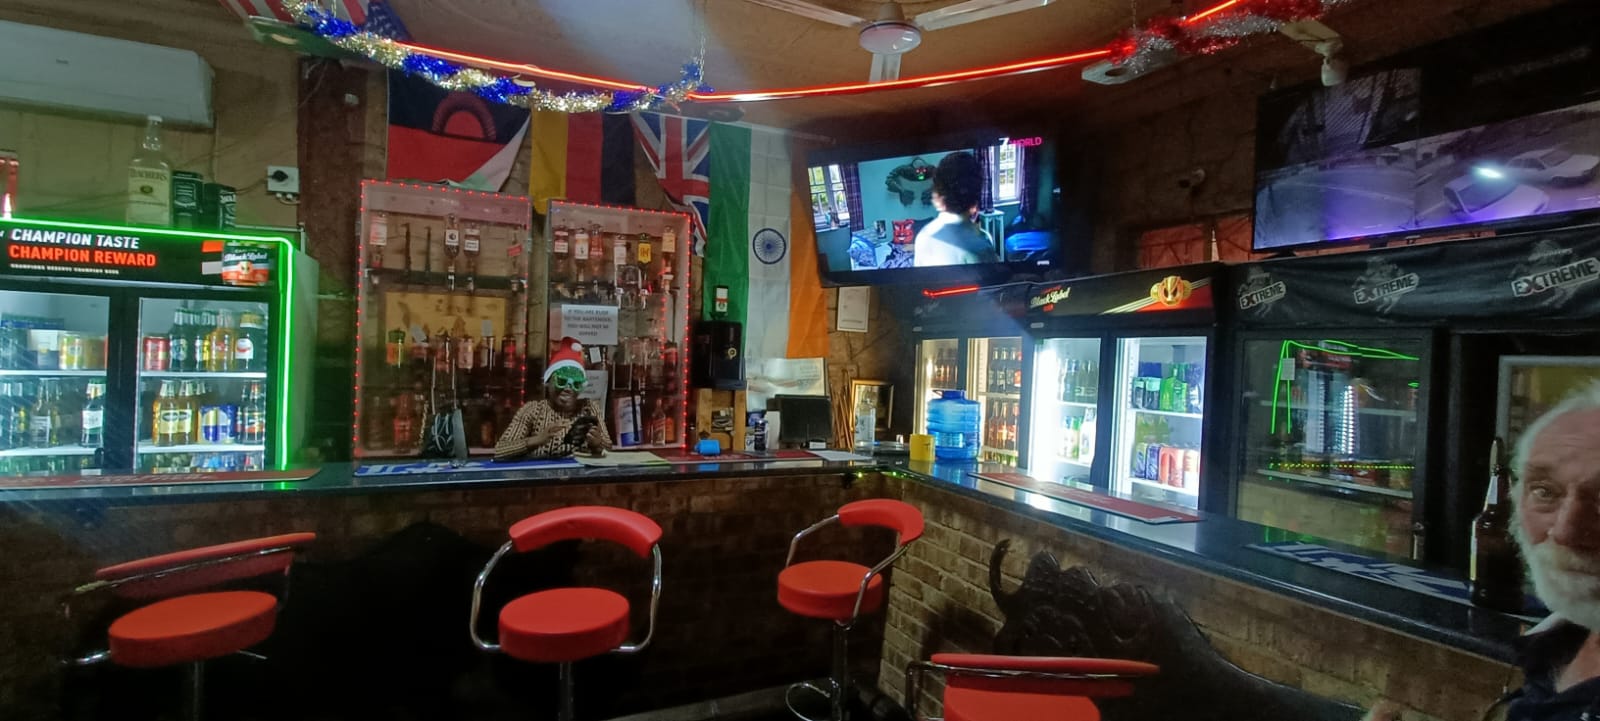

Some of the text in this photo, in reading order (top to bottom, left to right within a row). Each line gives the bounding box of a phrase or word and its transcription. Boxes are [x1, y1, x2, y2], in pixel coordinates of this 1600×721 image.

[11, 228, 140, 249] CHAMPION TASTE
[9, 245, 156, 267] CHAMPION REWARD
[1514, 259, 1599, 294] EXTREME
[1030, 293, 1050, 306] Black
[1049, 286, 1071, 303] Label
[1241, 283, 1284, 308] EXTREME
[1355, 274, 1415, 303] EXTREME
